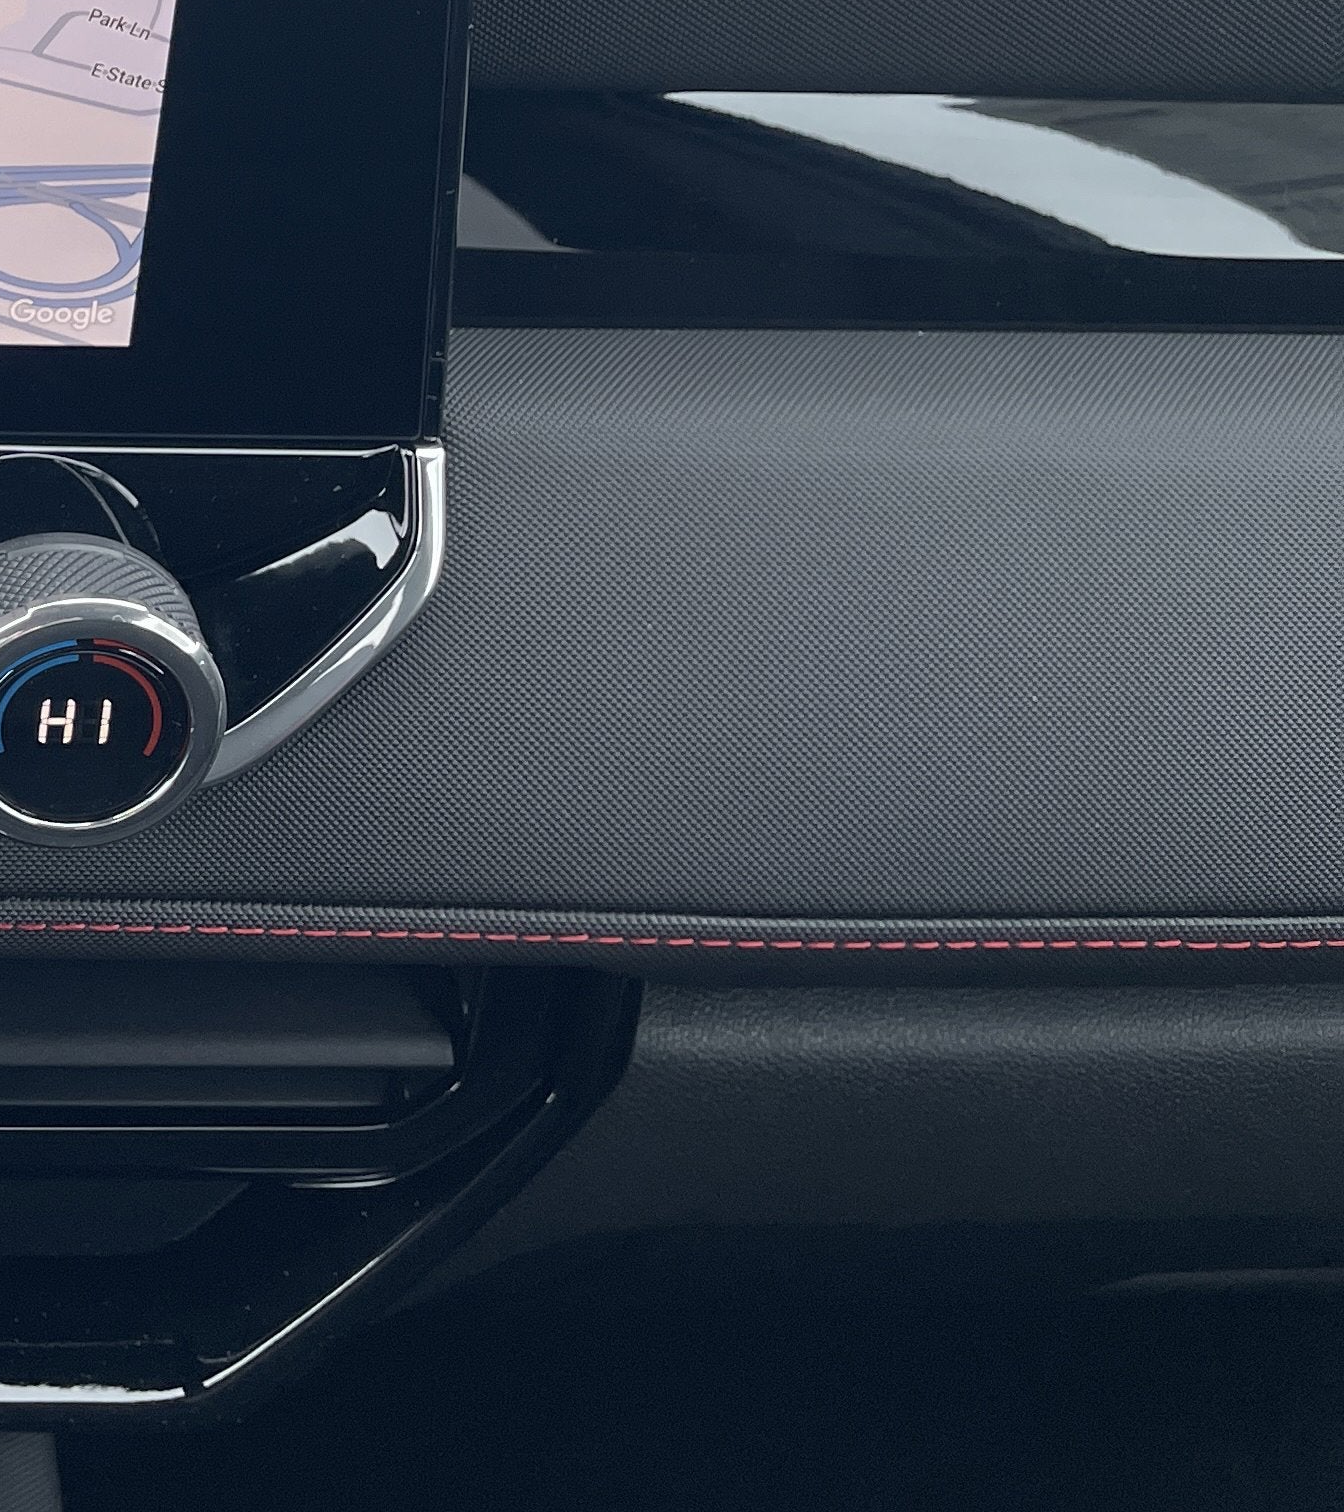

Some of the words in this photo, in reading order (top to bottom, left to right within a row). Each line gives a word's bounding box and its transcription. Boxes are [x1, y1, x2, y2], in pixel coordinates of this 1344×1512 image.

[88, 8, 127, 32] Park
[129, 22, 151, 40] Ln
[10, 300, 114, 329] Google
[38, 698, 113, 745] HI
